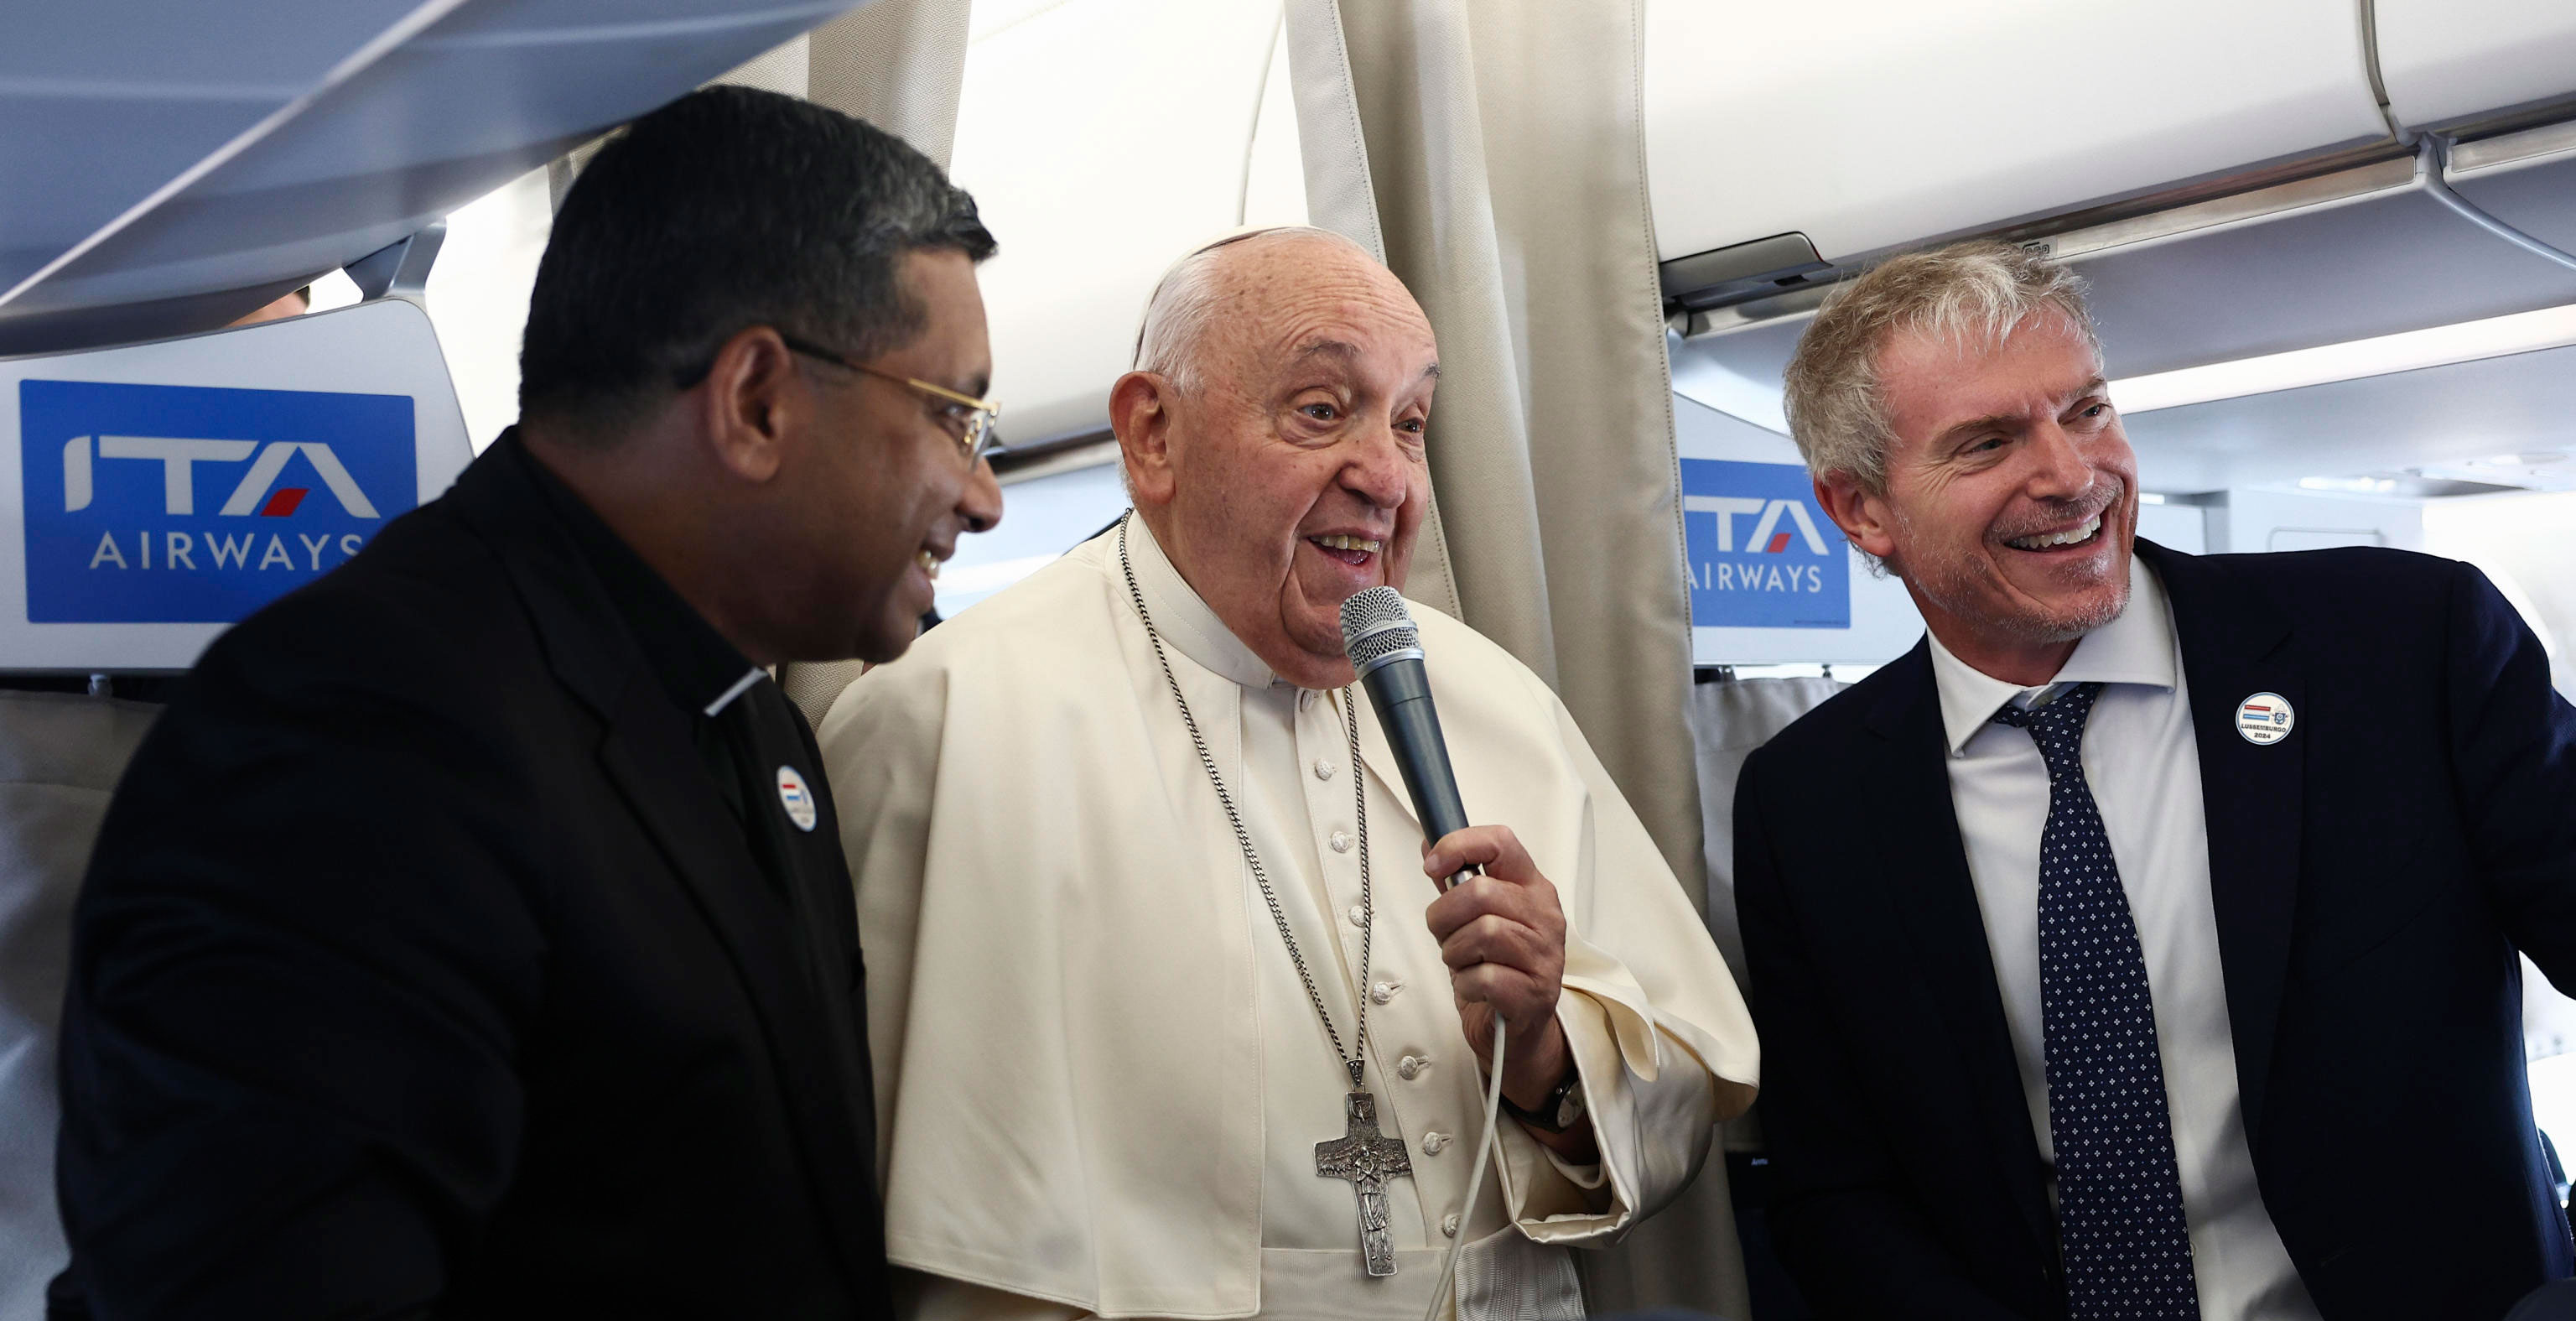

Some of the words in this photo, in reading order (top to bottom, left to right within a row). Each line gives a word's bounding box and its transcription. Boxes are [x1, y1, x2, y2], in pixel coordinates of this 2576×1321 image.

[64, 435, 381, 518] ITA
[1684, 496, 1830, 556] TA
[2241, 724, 2287, 732] LUSSEMBURGO
